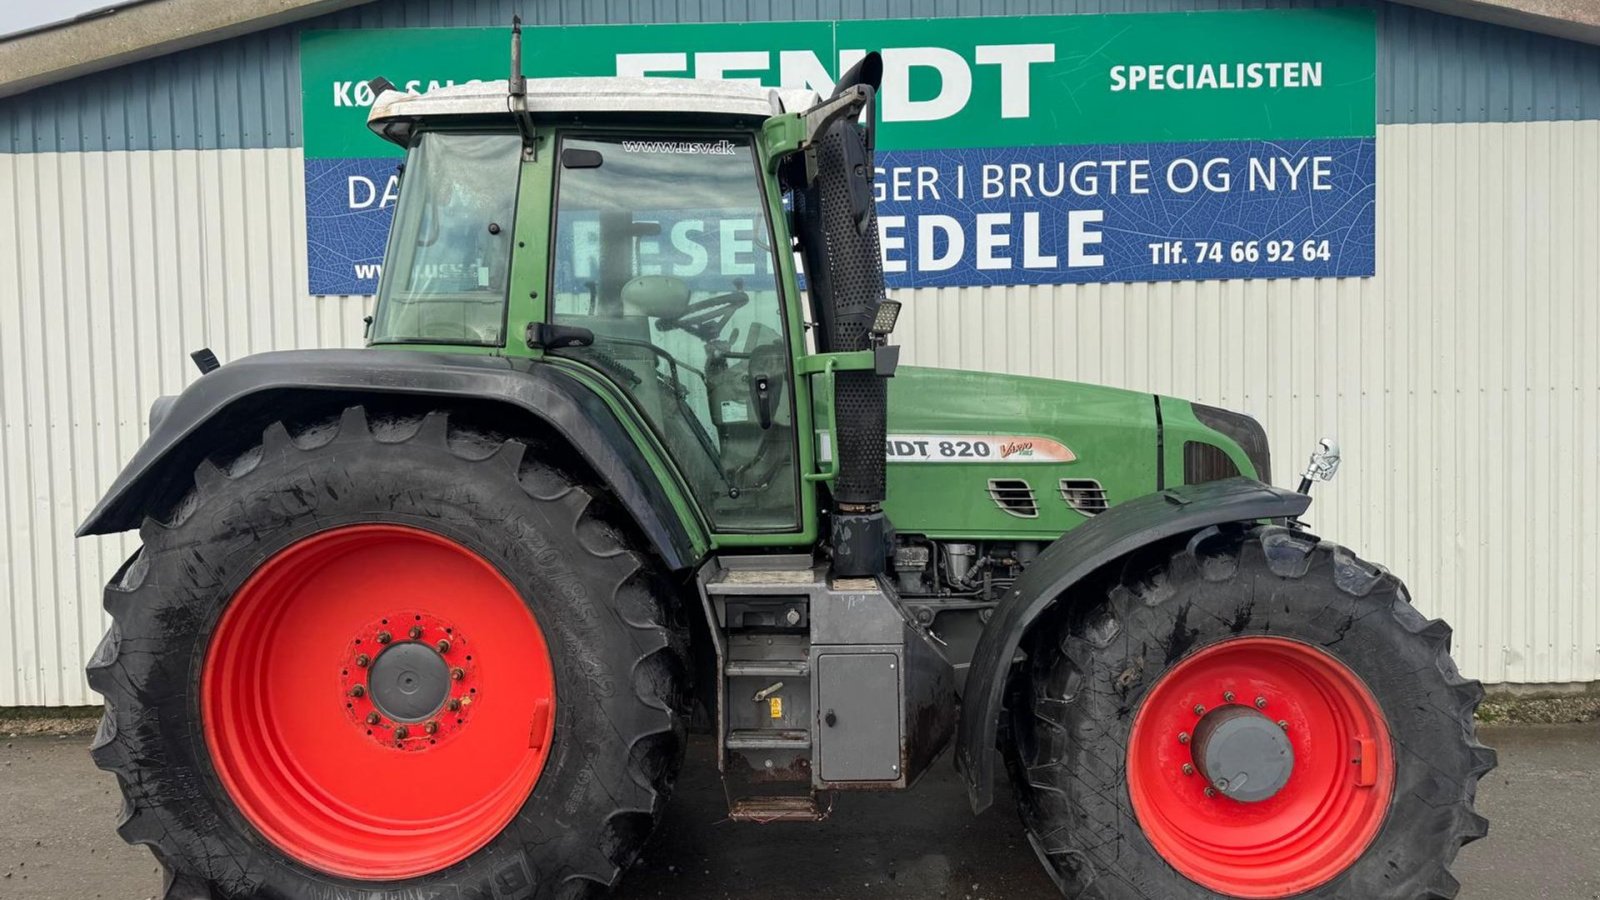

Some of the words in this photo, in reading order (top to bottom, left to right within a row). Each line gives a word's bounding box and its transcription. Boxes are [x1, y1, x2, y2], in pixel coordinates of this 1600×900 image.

[1110, 62, 1322, 91] SPECIALISTEN
[622, 139, 735, 155] www.usv.dk
[957, 165, 964, 200] I
[982, 160, 1150, 199] BRUGTE
[1166, 157, 1230, 194] OG
[1249, 156, 1332, 192] NYE
[1148, 240, 1187, 265] Tlf.
[1194, 241, 1224, 264] 74
[1230, 240, 1260, 263] 66
[1266, 240, 1295, 263] 92
[1302, 239, 1331, 262] 64
[886, 440, 929, 457] NDT
[938, 440, 991, 458] 820
